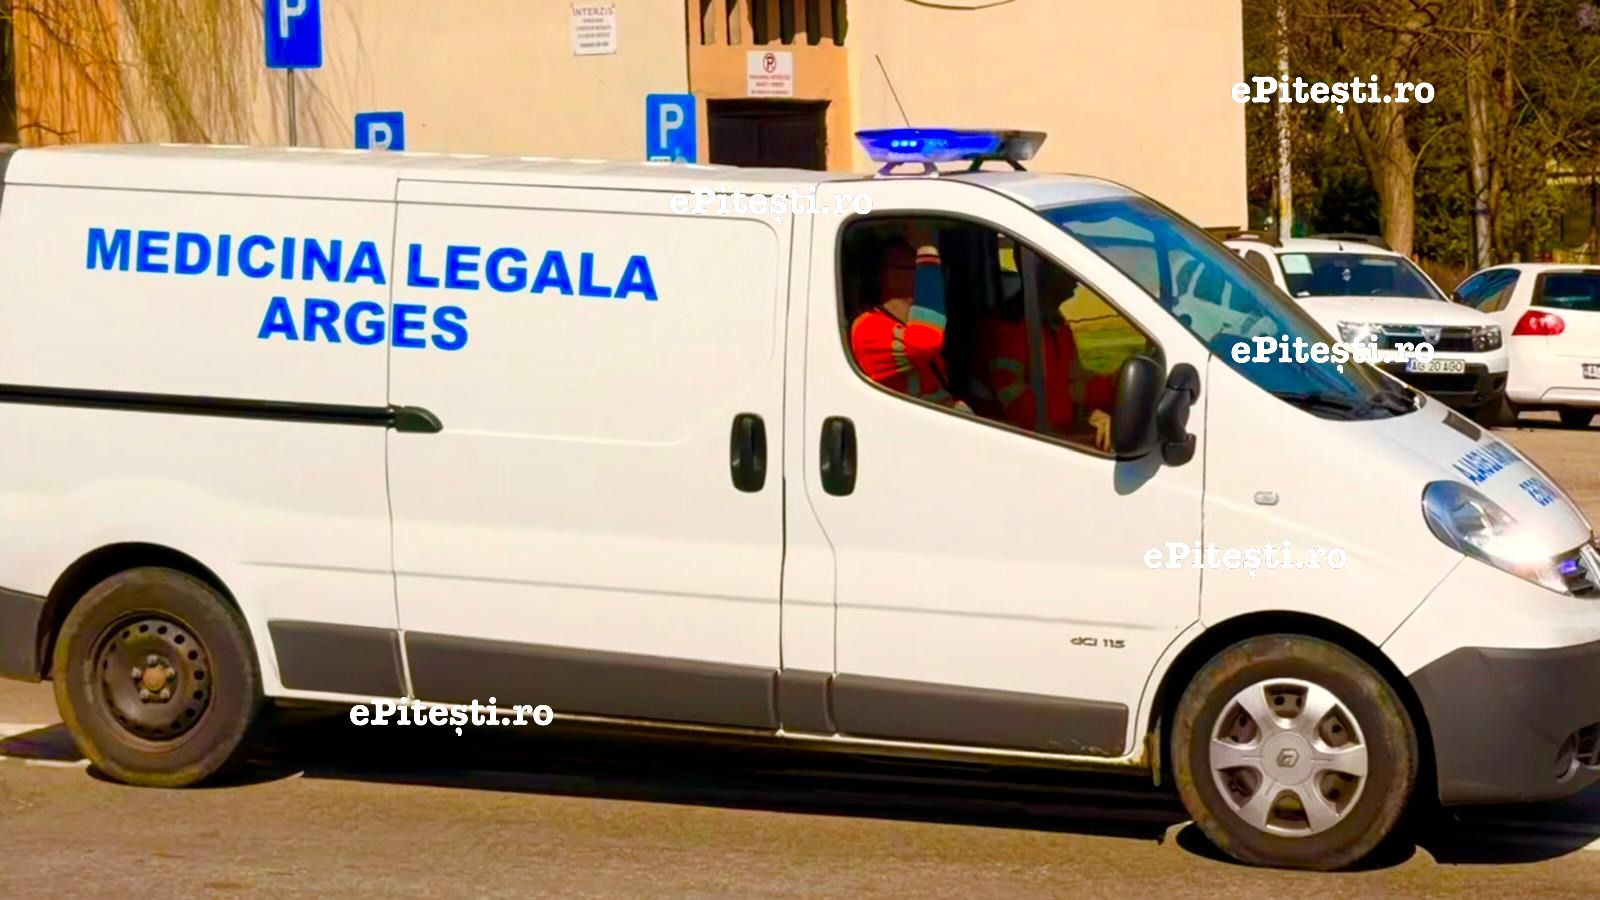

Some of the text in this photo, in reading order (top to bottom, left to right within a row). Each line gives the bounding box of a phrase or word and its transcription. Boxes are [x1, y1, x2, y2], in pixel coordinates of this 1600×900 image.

[279, 0, 306, 38] P
[367, 122, 392, 150] P
[660, 103, 684, 149] P
[86, 227, 658, 301] MEDICINA LEGALA
[258, 296, 469, 351] ARGES
[1103, 638, 1125, 648] 115
